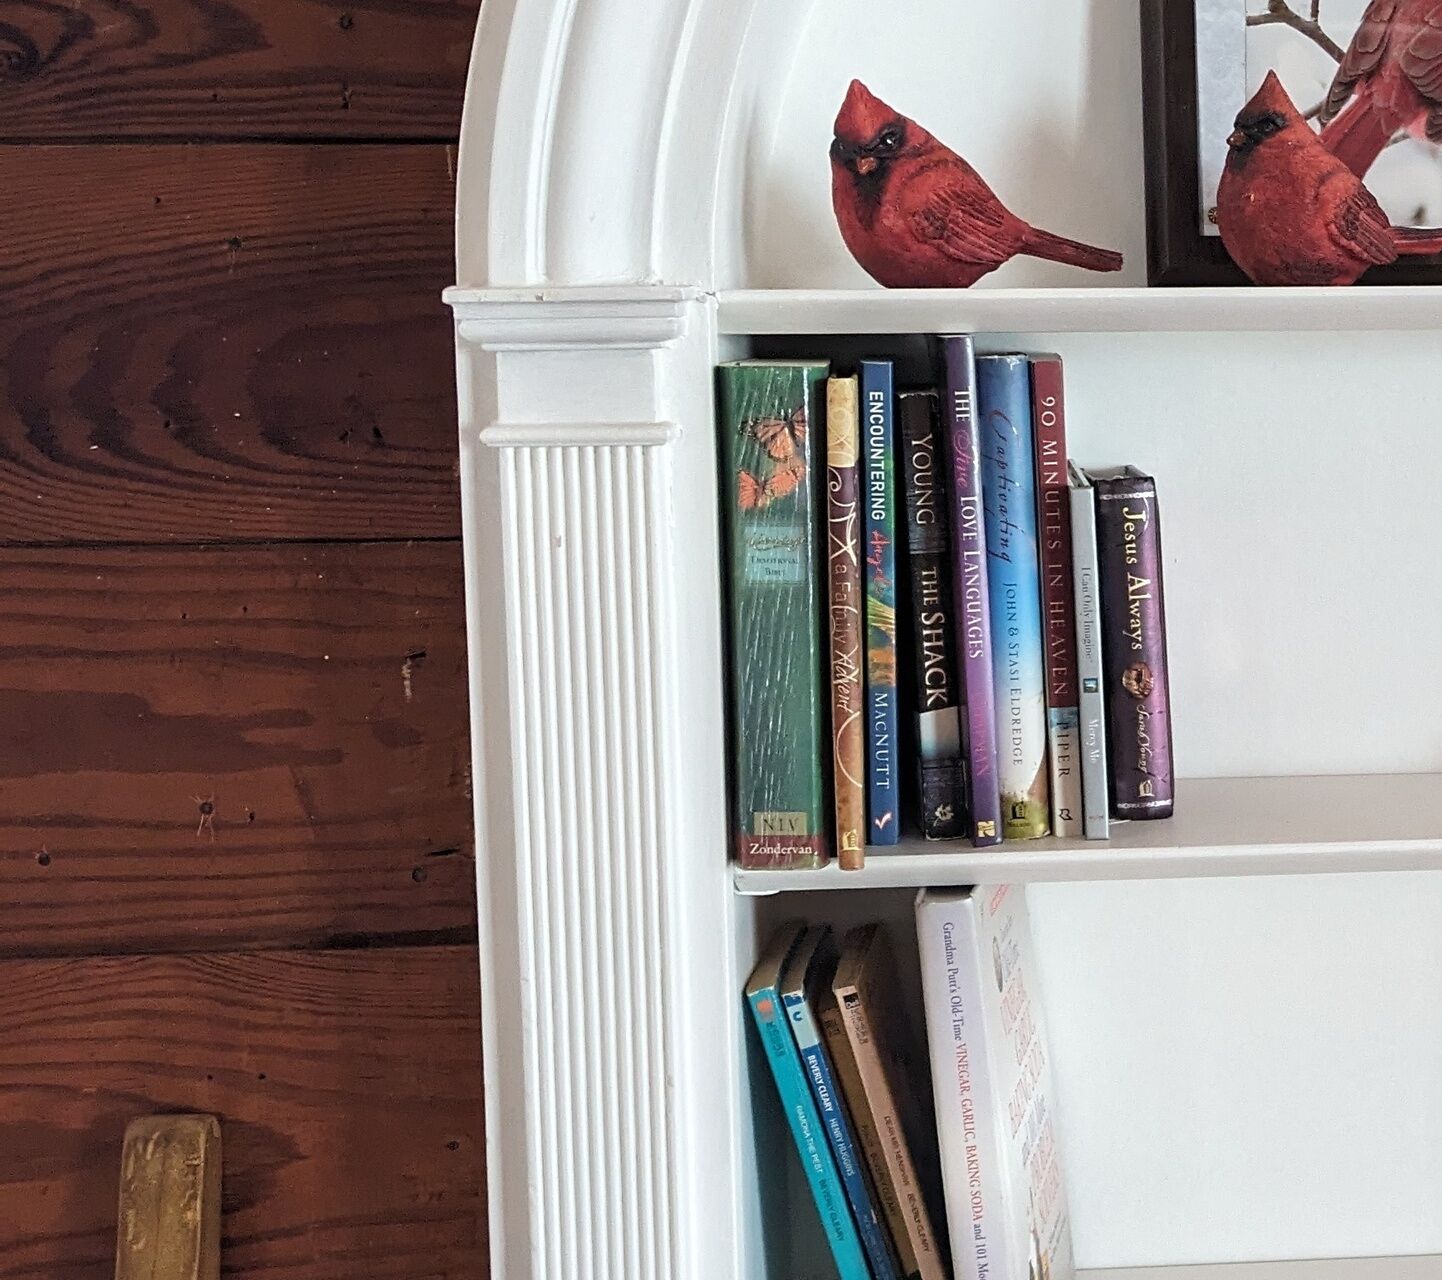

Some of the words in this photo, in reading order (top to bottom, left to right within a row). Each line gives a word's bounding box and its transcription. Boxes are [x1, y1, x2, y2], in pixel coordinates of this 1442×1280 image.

[954, 390, 971, 422] THE
[1041, 396, 1056, 427] 90
[869, 391, 885, 521] ENCOUNTERING
[911, 433, 935, 525] YOUNG
[983, 409, 1024, 564] Captivating
[1042, 440, 1063, 550] MINUTES
[960, 496, 978, 541] LOVE
[1122, 507, 1146, 564] Jesus
[922, 568, 939, 605] THE
[1048, 564, 1063, 586] IN
[1081, 573, 1092, 591] Can
[963, 550, 983, 659] LANGUAGES
[1003, 583, 1018, 621] JOHN
[1080, 594, 1093, 619] Only
[1122, 572, 1152, 650] Always
[1008, 627, 1018, 637] &
[1050, 601, 1068, 695] HEAVEN
[833, 645, 859, 713] Advent
[921, 613, 947, 707] SHACK
[1008, 642, 1020, 681] STASI
[1010, 688, 1023, 766] ELDREDGE
[1137, 704, 1150, 738] Sarah
[1056, 722, 1070, 778] PIPER
[1138, 735, 1153, 774] Young
[763, 818, 798, 832] NIV
[942, 922, 957, 966] Grandma
[950, 995, 965, 1041] Old-Time
[807, 1054, 824, 1086] BEVERLY
[817, 1084, 834, 1112] CLEARY
[829, 1118, 843, 1146] HENRY
[838, 1142, 856, 1177] HUGGINS
[961, 1098, 976, 1143] GARLIC,
[965, 1144, 981, 1188] BAKING
[970, 1190, 983, 1222] SODA
[974, 1224, 986, 1240] and
[975, 1244, 987, 1261] 101
